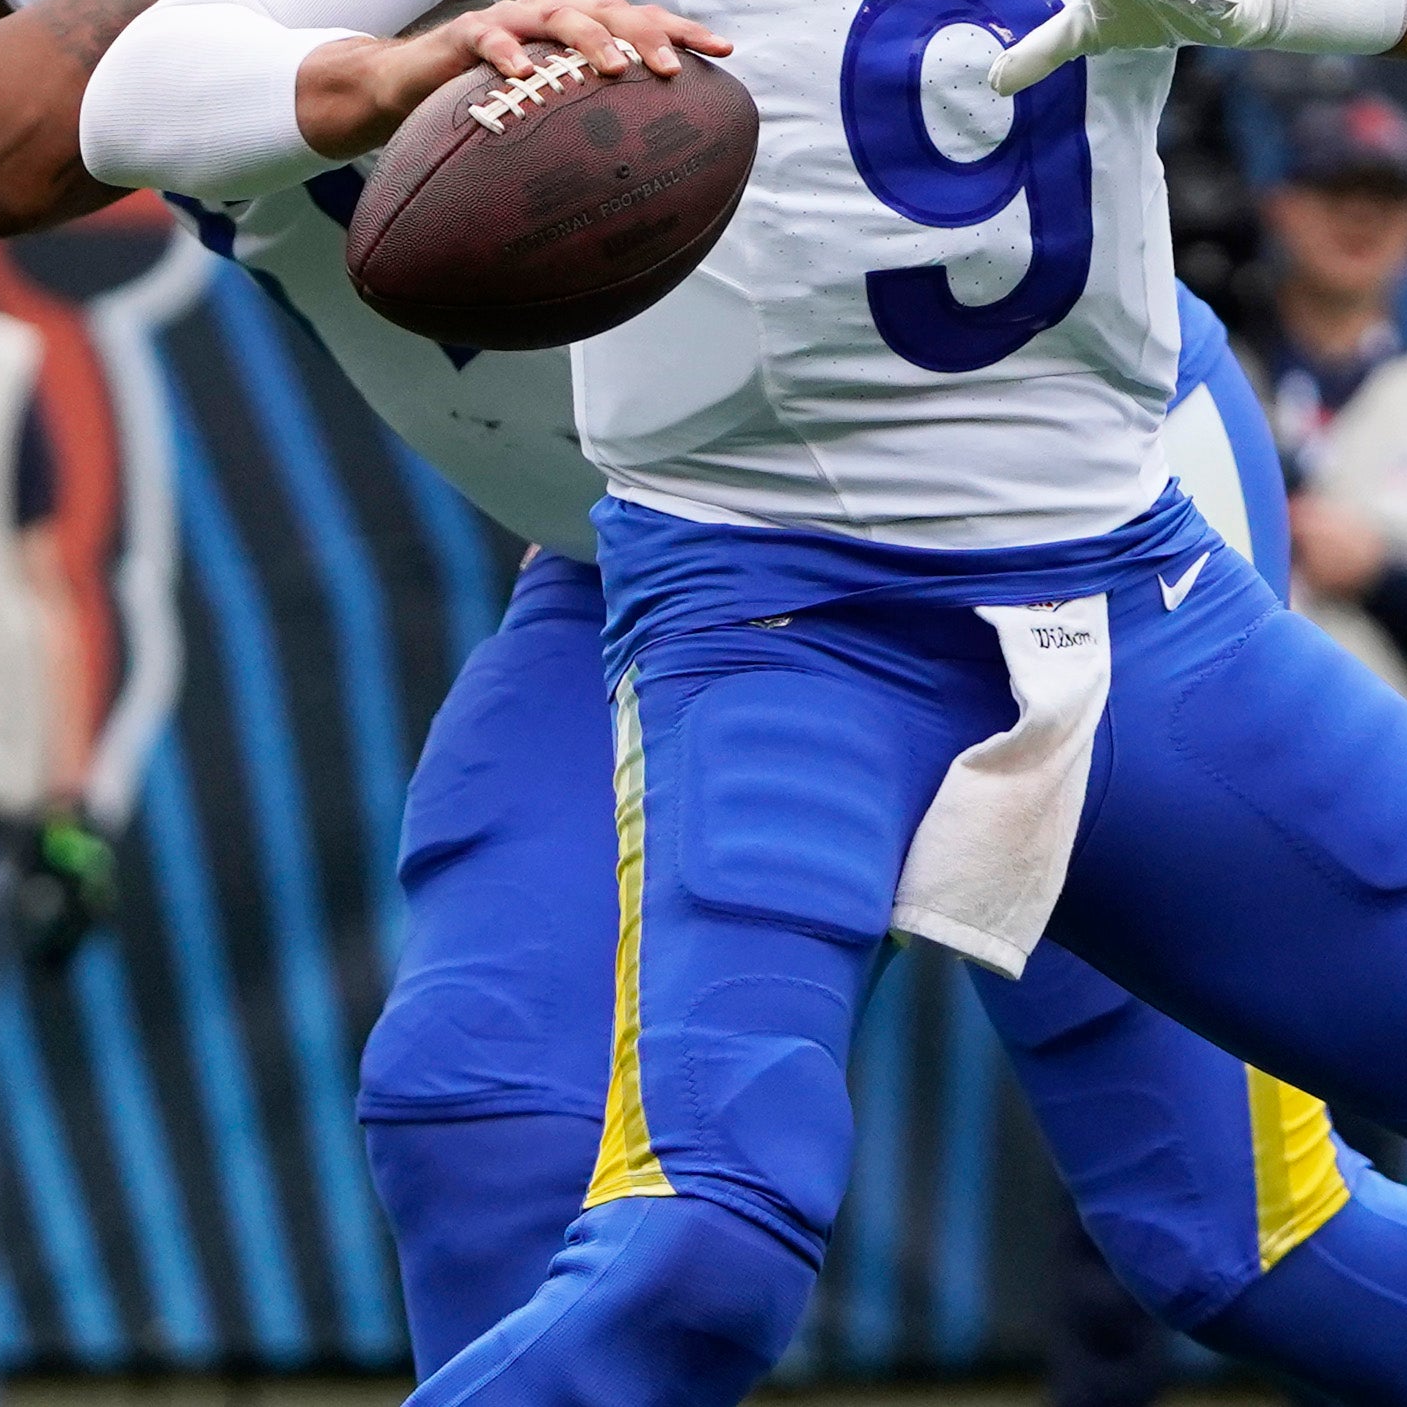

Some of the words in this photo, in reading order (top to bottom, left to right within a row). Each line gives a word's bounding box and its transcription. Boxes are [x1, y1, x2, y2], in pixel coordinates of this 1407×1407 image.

[504, 211, 593, 257] NIONAL
[599, 169, 681, 220] FOOTBALL
[1030, 626, 1092, 649] Wilson
